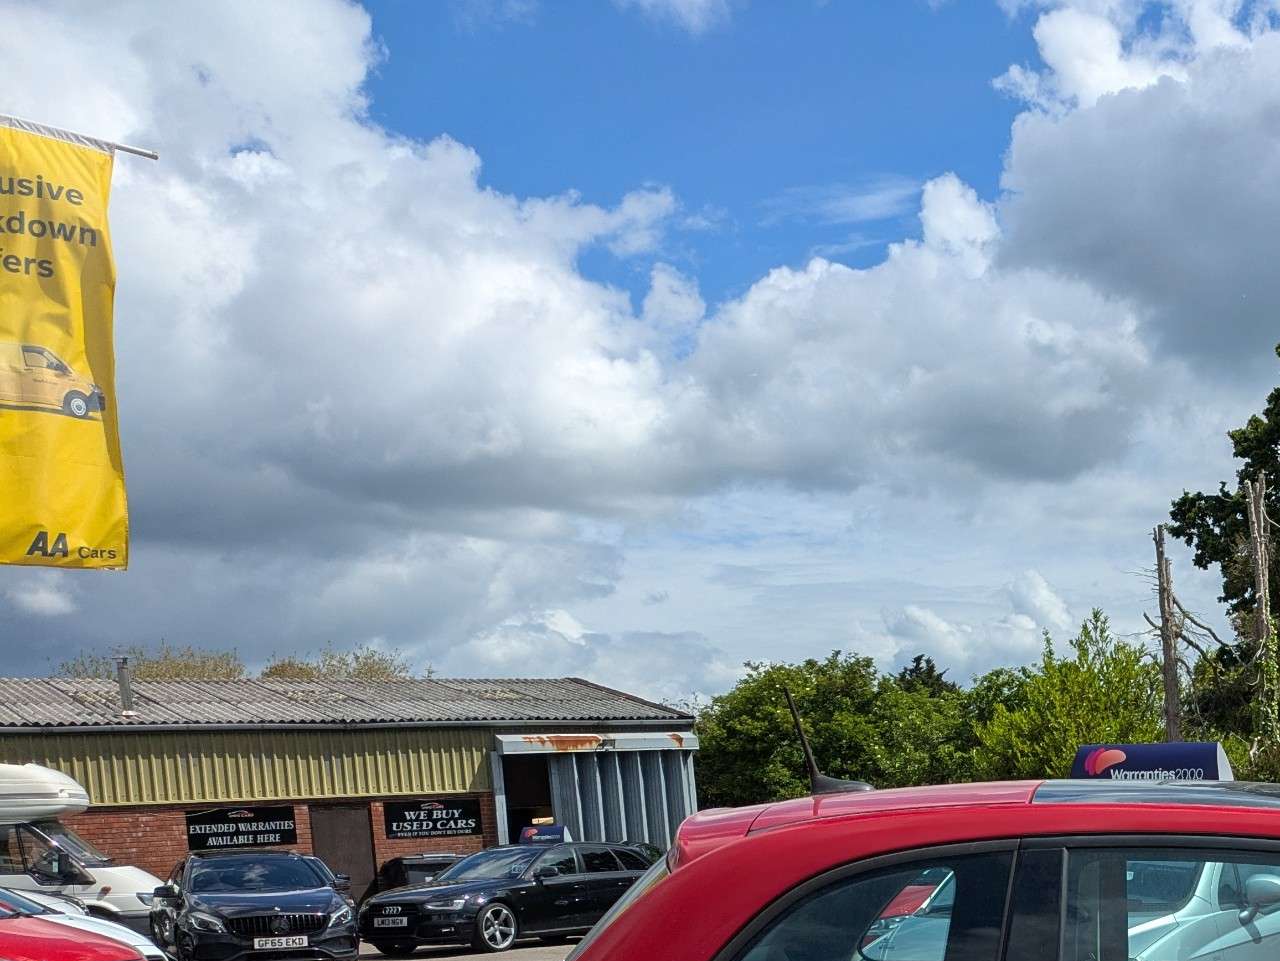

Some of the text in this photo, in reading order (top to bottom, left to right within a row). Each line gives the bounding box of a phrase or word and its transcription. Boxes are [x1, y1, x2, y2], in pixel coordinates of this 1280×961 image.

[0, 247, 54, 278] ers
[25, 530, 117, 559] AA Cars
[1110, 767, 1204, 780] Warranties2000
[404, 809, 462, 820] WE BUY
[189, 820, 294, 834] EXTENDED WARRANTIES
[392, 819, 476, 831] USED CARS
[206, 833, 281, 846] AVAILABLE HERE
[257, 937, 304, 948] GF65 EKD
